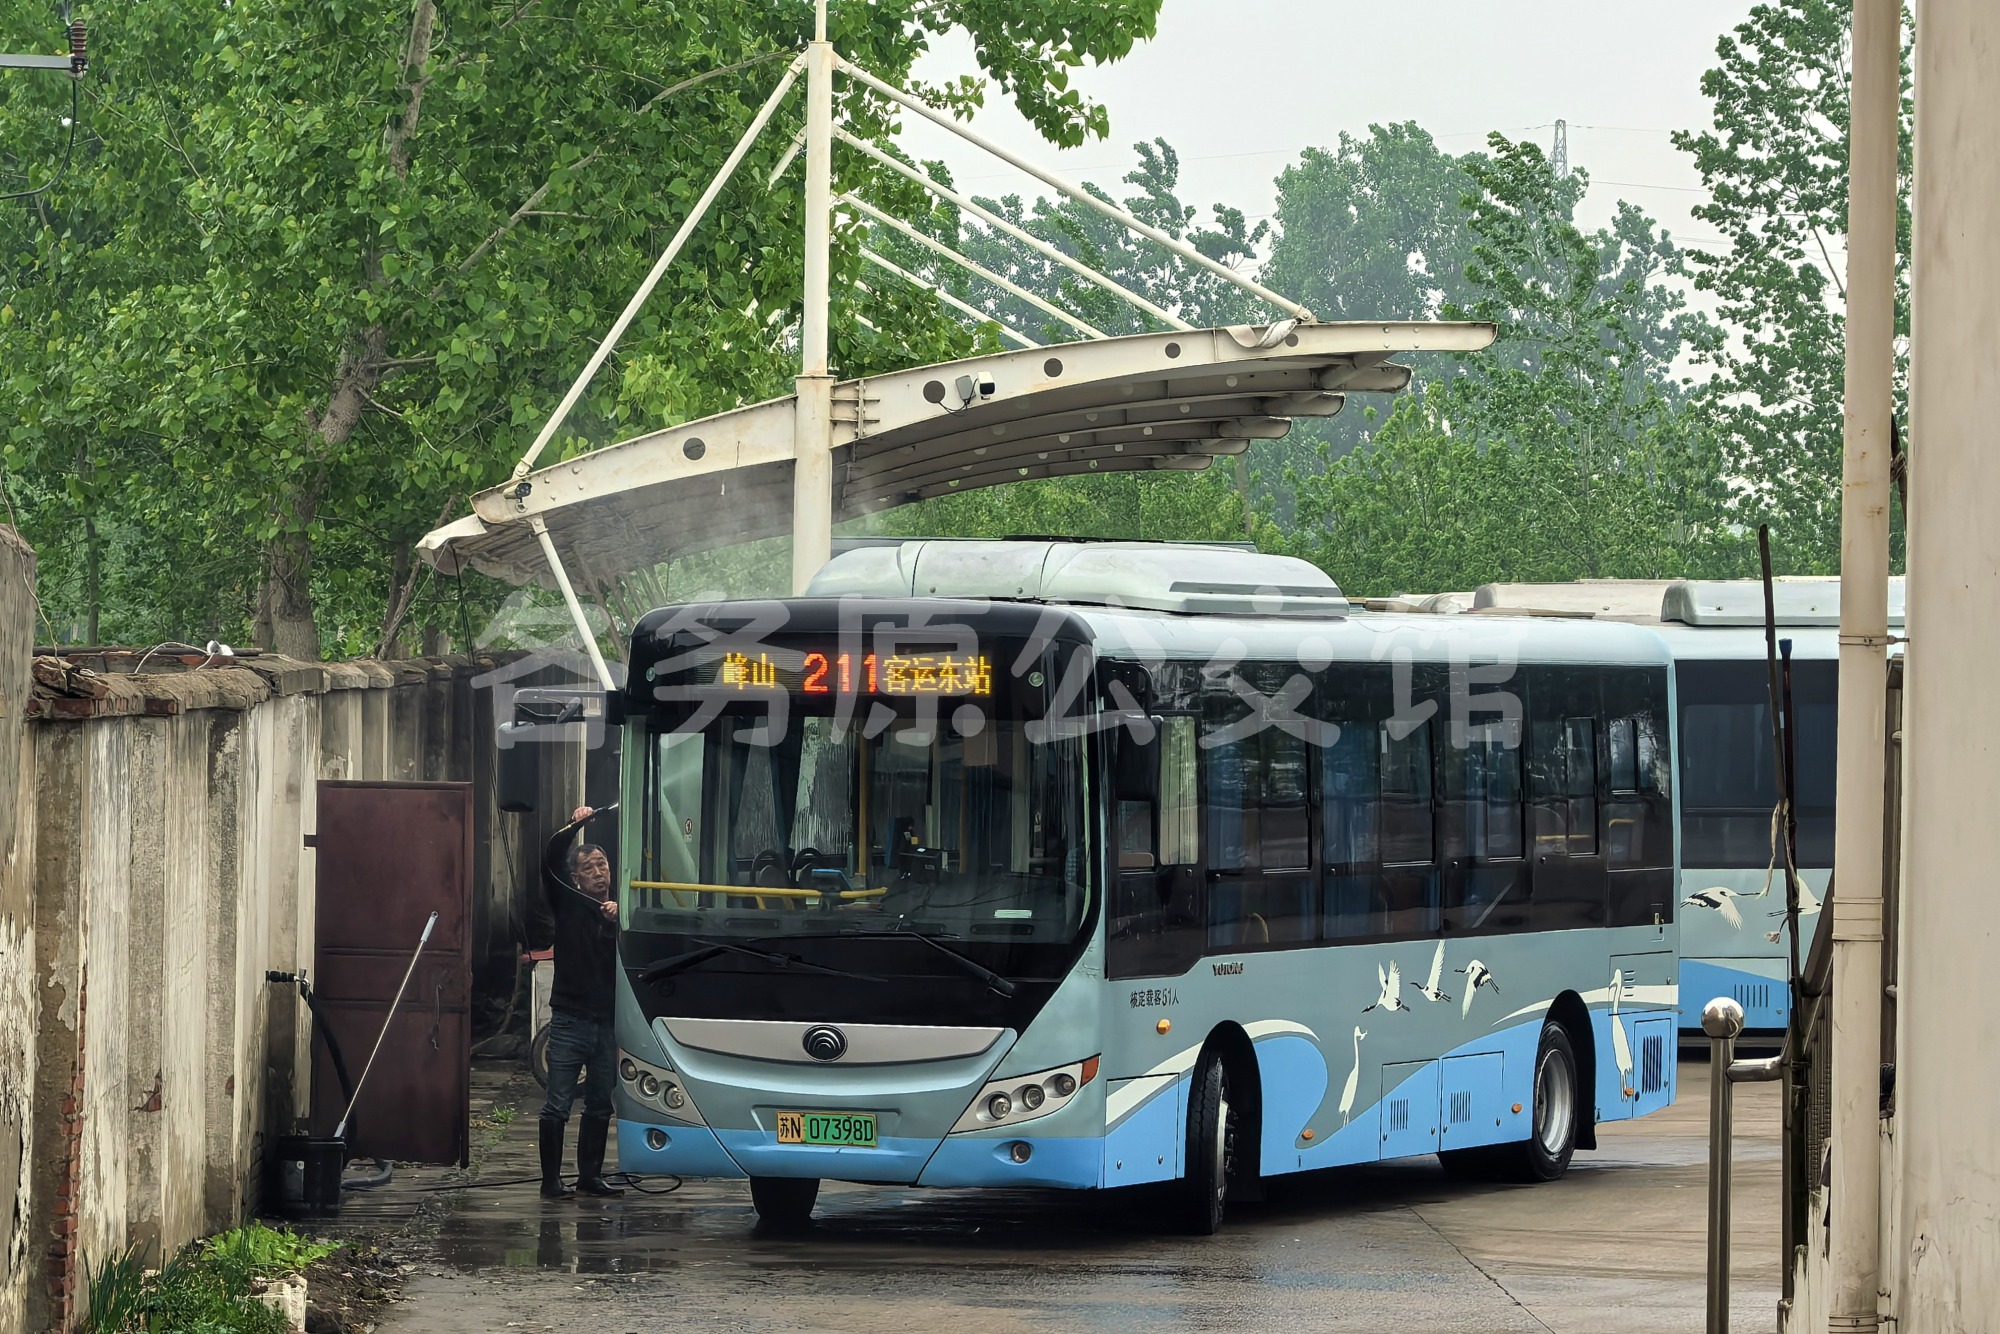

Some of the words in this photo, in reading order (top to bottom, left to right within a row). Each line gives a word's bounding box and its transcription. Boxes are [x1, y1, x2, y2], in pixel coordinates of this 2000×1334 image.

[723, 653, 774, 690] 峰山
[804, 653, 876, 693] 211
[882, 655, 991, 694] 客运东站
